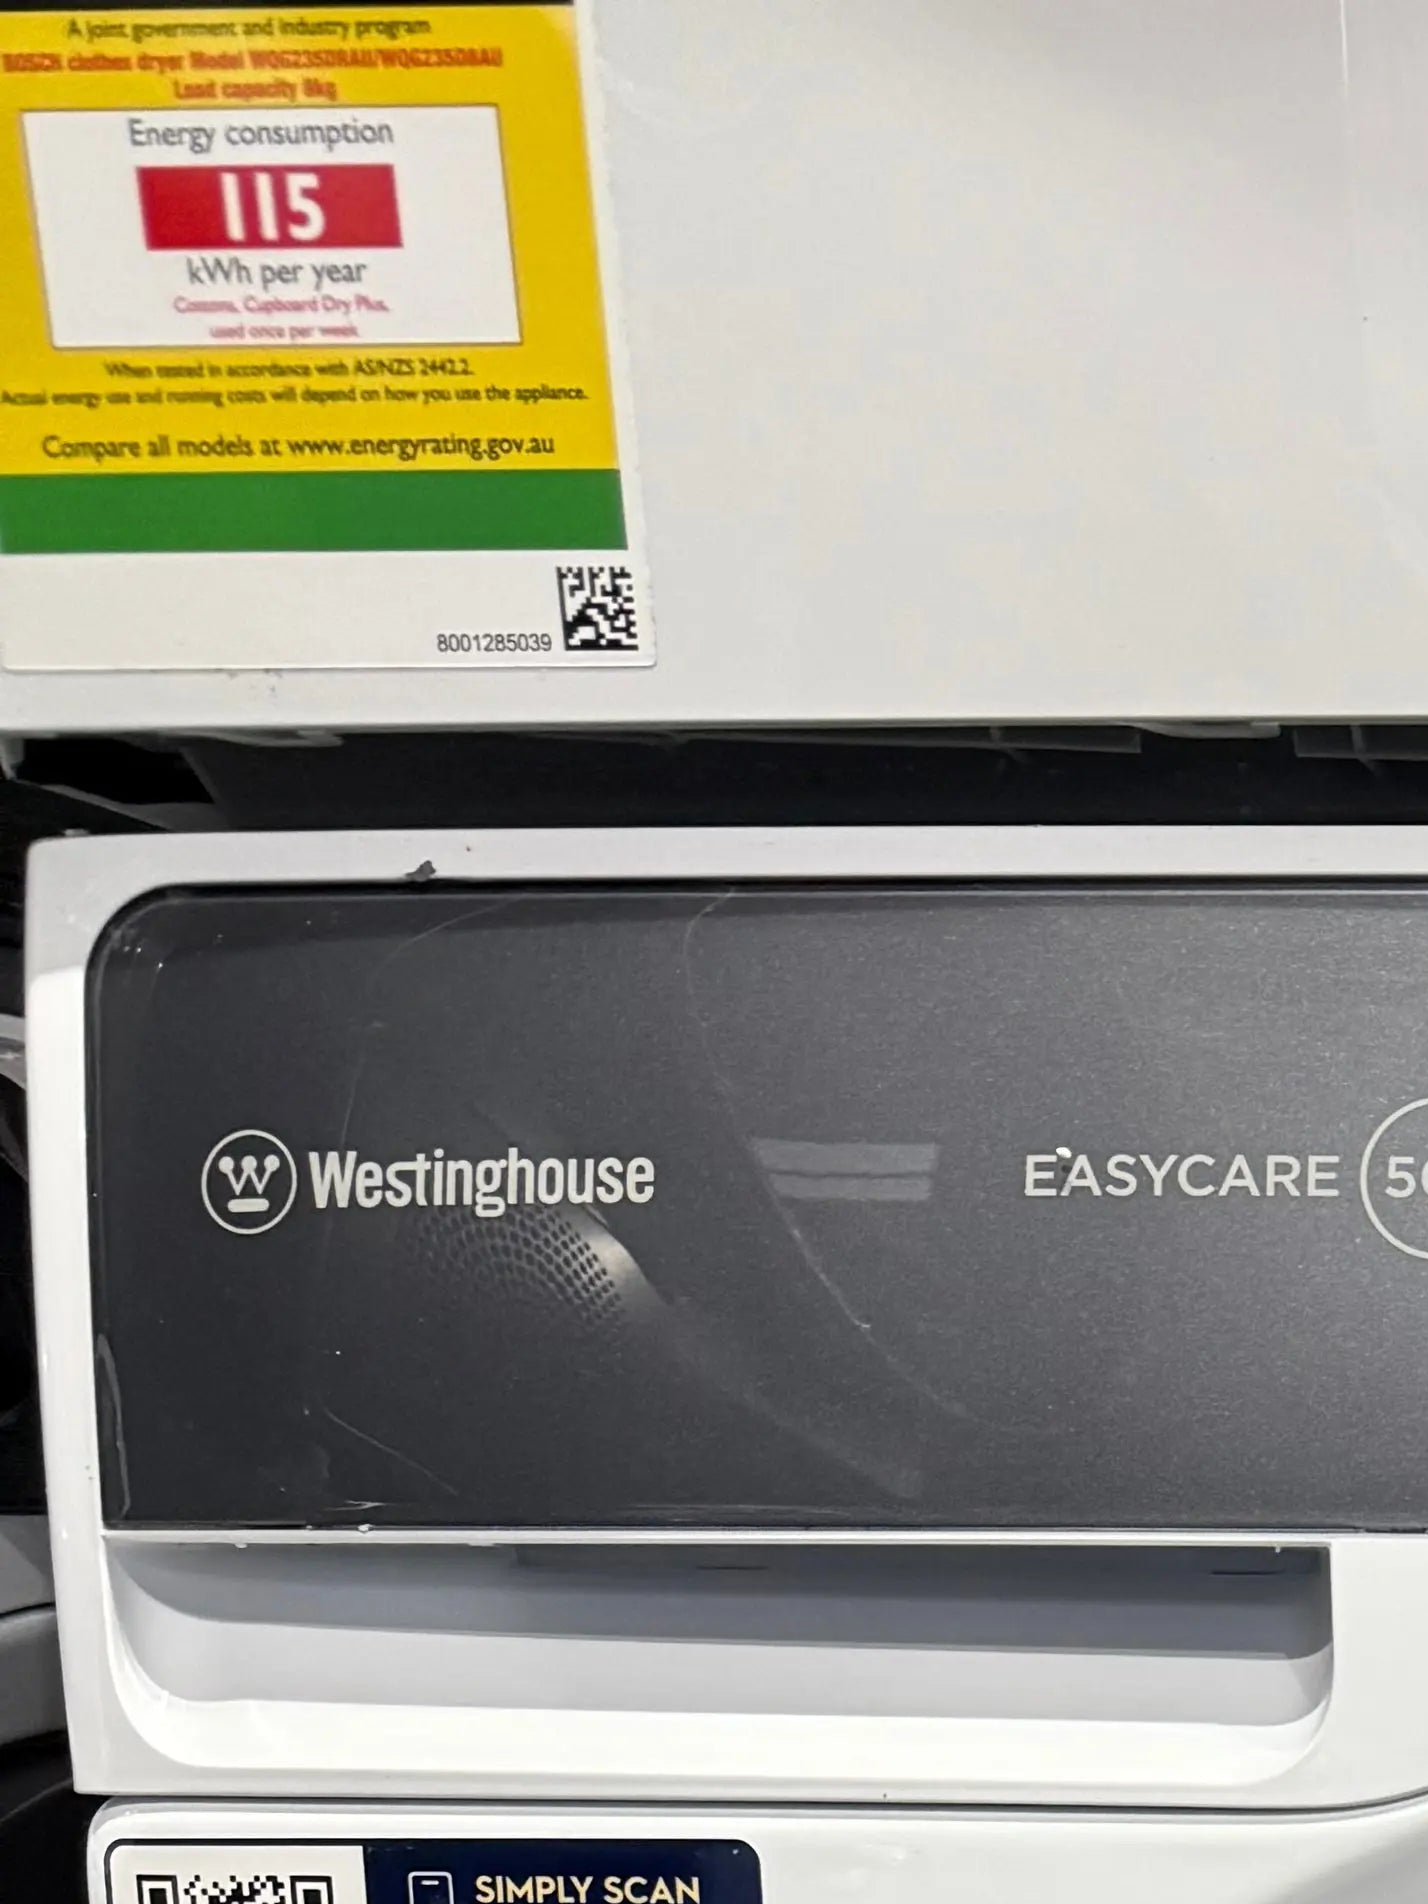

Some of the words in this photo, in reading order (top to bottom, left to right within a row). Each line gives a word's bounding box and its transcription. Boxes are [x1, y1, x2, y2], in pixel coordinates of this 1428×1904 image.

[128, 118, 216, 154] Energy
[224, 117, 394, 152] consumption
[220, 171, 326, 242] 115
[186, 257, 252, 285] kWh
[260, 263, 304, 292] per
[309, 262, 367, 291] year
[384, 385, 417, 401] how
[422, 388, 450, 404] you
[455, 388, 481, 401] use
[486, 384, 510, 401] the
[515, 382, 589, 404] appliance.
[42, 434, 141, 465] Compare
[148, 433, 170, 457] all
[177, 433, 254, 457] models
[260, 436, 282, 456] at
[286, 432, 555, 462] www.energyrating.gov.au
[437, 633, 552, 652] 8001285039
[308, 1147, 655, 1218] Westinghouse
[1023, 1152, 1340, 1198] EASYCARE
[475, 1875, 594, 1904] SIMPLY
